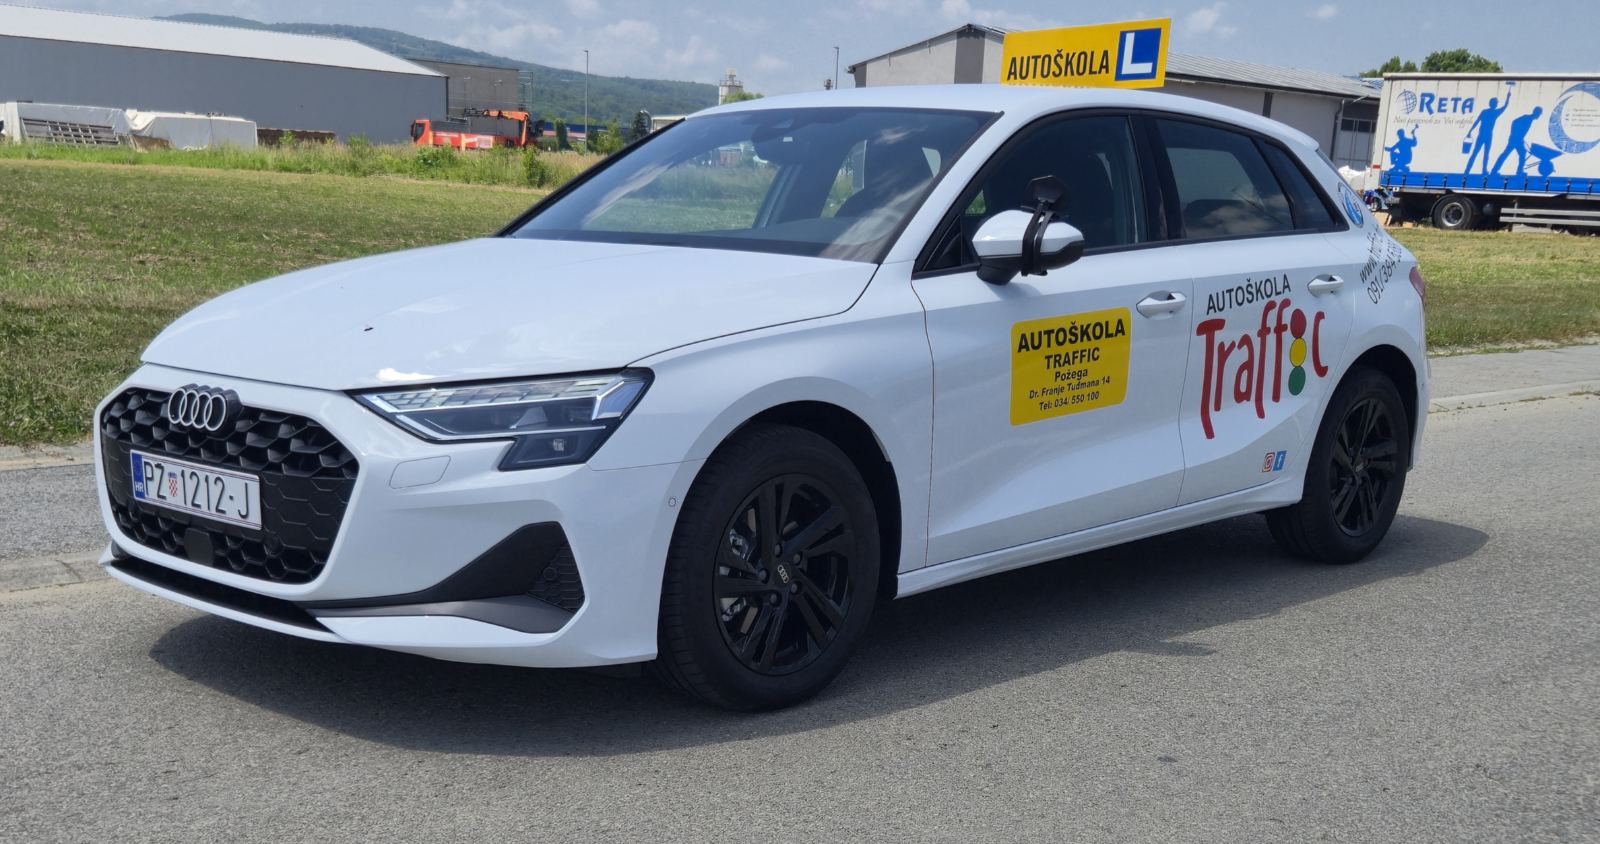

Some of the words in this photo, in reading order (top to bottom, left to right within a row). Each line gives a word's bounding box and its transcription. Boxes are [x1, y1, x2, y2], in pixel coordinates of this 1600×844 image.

[1007, 49, 1110, 81] AUTOŠKOLA
[1121, 32, 1153, 75] L
[1419, 92, 1475, 115] RETA
[1206, 274, 1291, 315] AUTOŠKOLA
[1017, 318, 1126, 353] AUTOŠKOLA
[1045, 347, 1100, 370] TRAFFIC
[1054, 368, 1088, 382] Požega
[1029, 390, 1039, 399] Dr.
[1041, 385, 1065, 396] Franje
[1102, 376, 1110, 384] 14
[1071, 394, 1085, 405] 550
[1087, 391, 1100, 401] 100
[135, 481, 144, 493] HR
